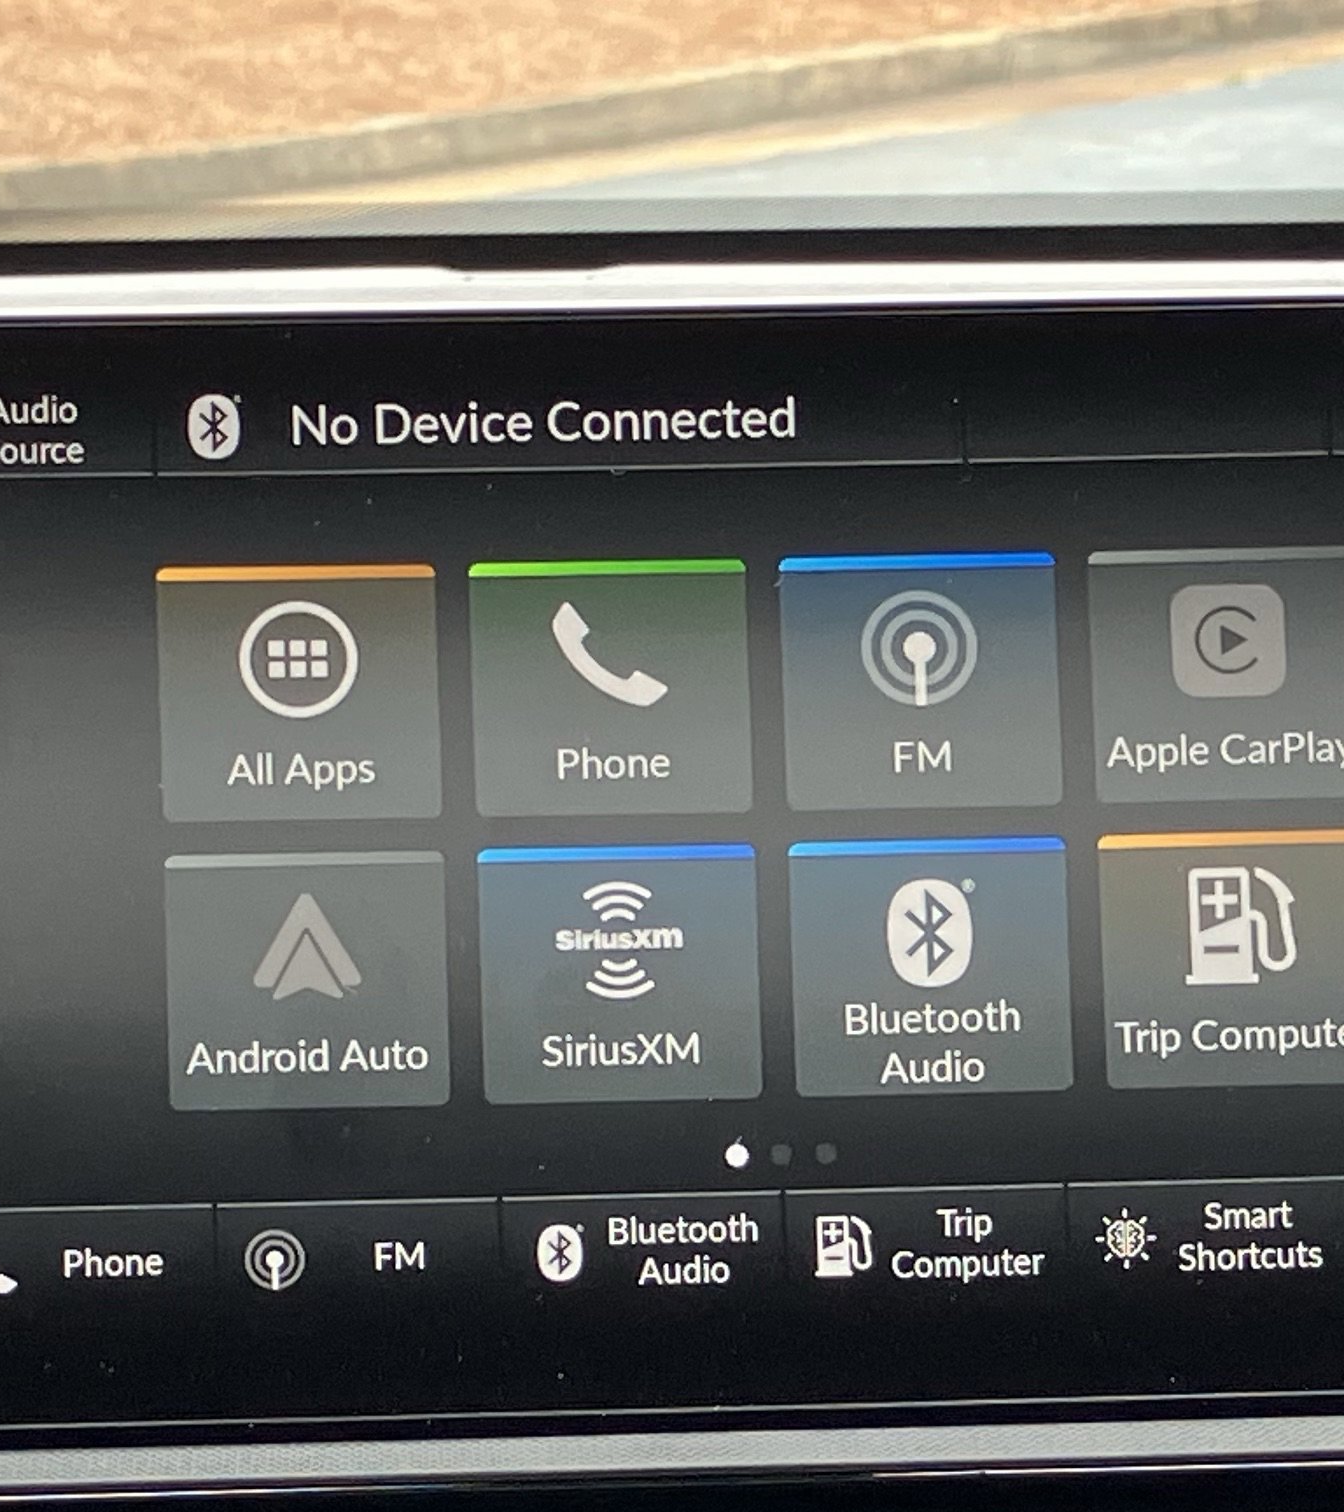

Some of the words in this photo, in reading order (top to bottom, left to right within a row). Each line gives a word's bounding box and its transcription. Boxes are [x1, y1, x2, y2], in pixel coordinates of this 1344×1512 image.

[292, 404, 359, 446] No
[374, 400, 533, 445] Device
[547, 395, 796, 442] Connected
[557, 746, 671, 780] Phone
[894, 740, 952, 773] FM
[1106, 733, 1210, 774] Apple
[226, 752, 274, 786] All
[284, 752, 376, 791] Apps
[844, 998, 1021, 1036] Bluetooth
[186, 1038, 330, 1075] Android
[339, 1039, 429, 1072] Auto
[542, 1031, 700, 1067] SiriusXM
[1114, 1019, 1182, 1060] Trip
[880, 1049, 985, 1084] Audio
[608, 1212, 759, 1246] Bluetooth
[935, 1206, 993, 1244] Trip
[1204, 1200, 1294, 1231] Smart
[63, 1247, 164, 1279] Phone
[374, 1241, 426, 1271] FM
[638, 1254, 731, 1286] Audio
[891, 1248, 1046, 1284] Computer
[1178, 1240, 1324, 1272] Shortcuts
